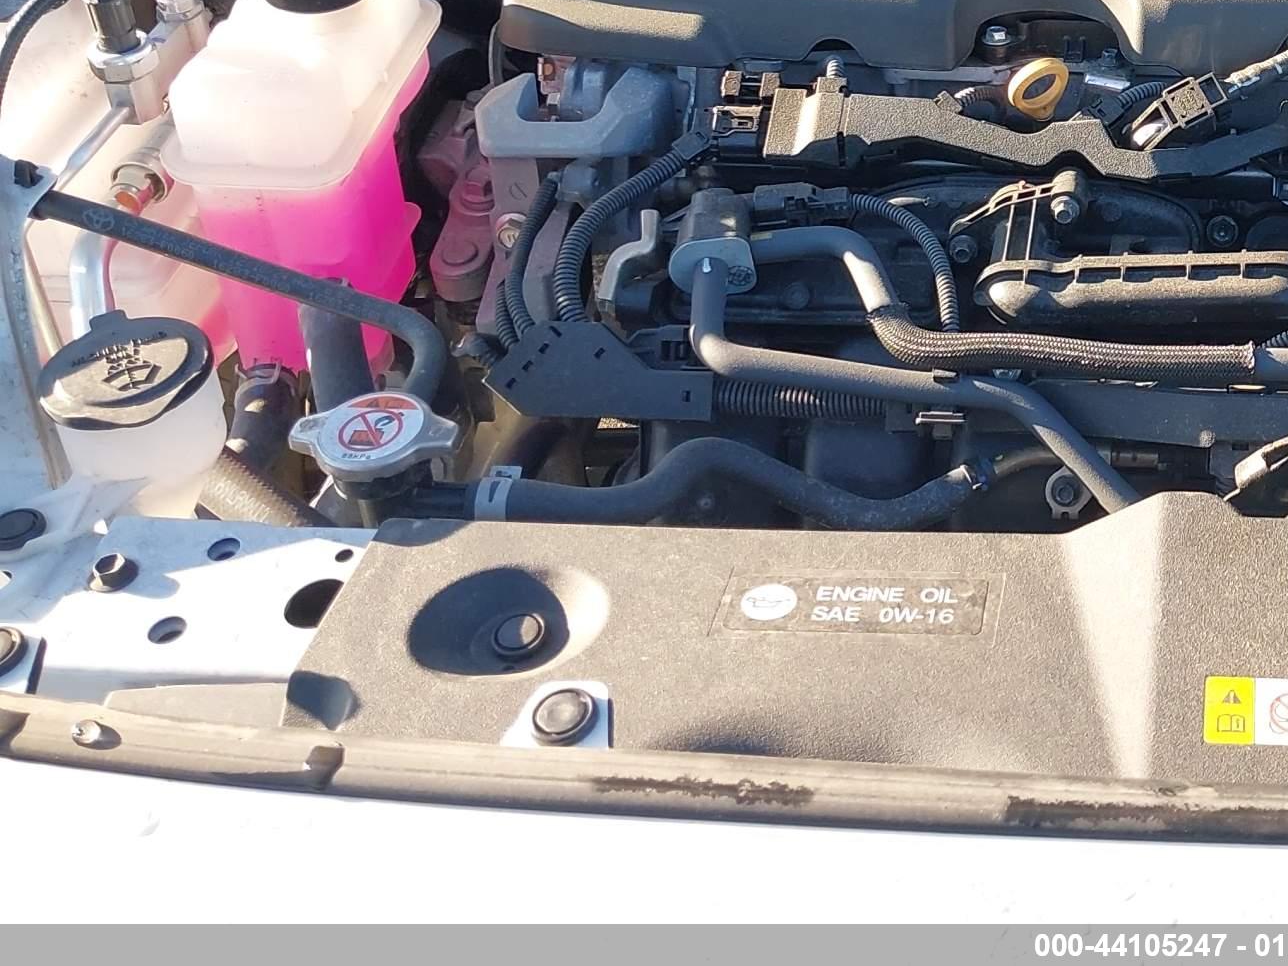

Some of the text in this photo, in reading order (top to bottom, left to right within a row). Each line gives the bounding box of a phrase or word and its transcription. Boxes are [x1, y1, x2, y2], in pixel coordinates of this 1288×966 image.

[815, 585, 958, 604] ENGINE OIL
[810, 605, 955, 625] SAE 0W-16
